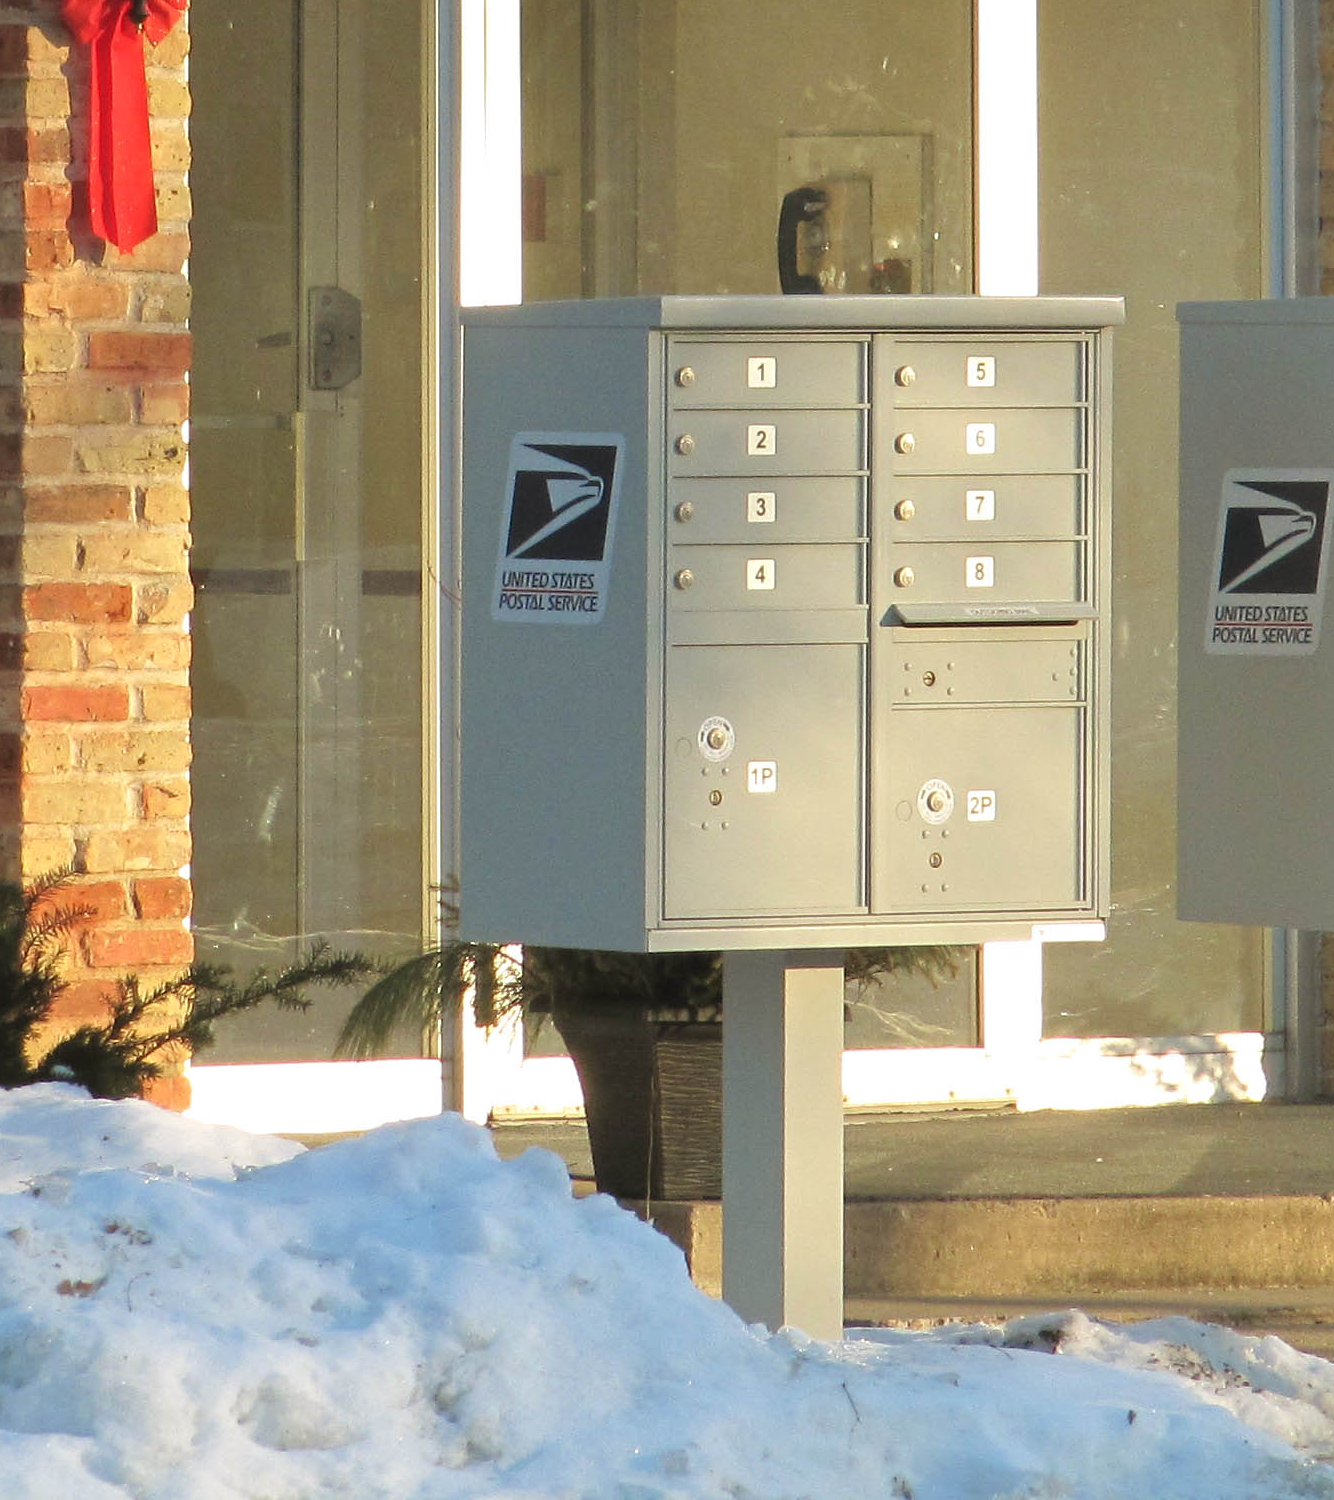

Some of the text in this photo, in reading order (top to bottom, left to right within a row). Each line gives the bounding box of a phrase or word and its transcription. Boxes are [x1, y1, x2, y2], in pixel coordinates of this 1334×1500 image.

[757, 363, 765, 382] 1
[976, 362, 986, 381] 5
[755, 430, 767, 449] 2
[975, 429, 986, 448] 6
[756, 497, 767, 517] 3
[975, 495, 985, 514] 7
[502, 572, 596, 590] UNITED STATES
[754, 564, 766, 583] 4
[974, 562, 985, 581] 8
[499, 593, 599, 612] POSTAL SERVICE
[1215, 605, 1309, 622] UNITED STATES
[1212, 627, 1313, 644] POSTAL SERVICE
[751, 767, 774, 785] 1P
[970, 795, 993, 815] 2P
